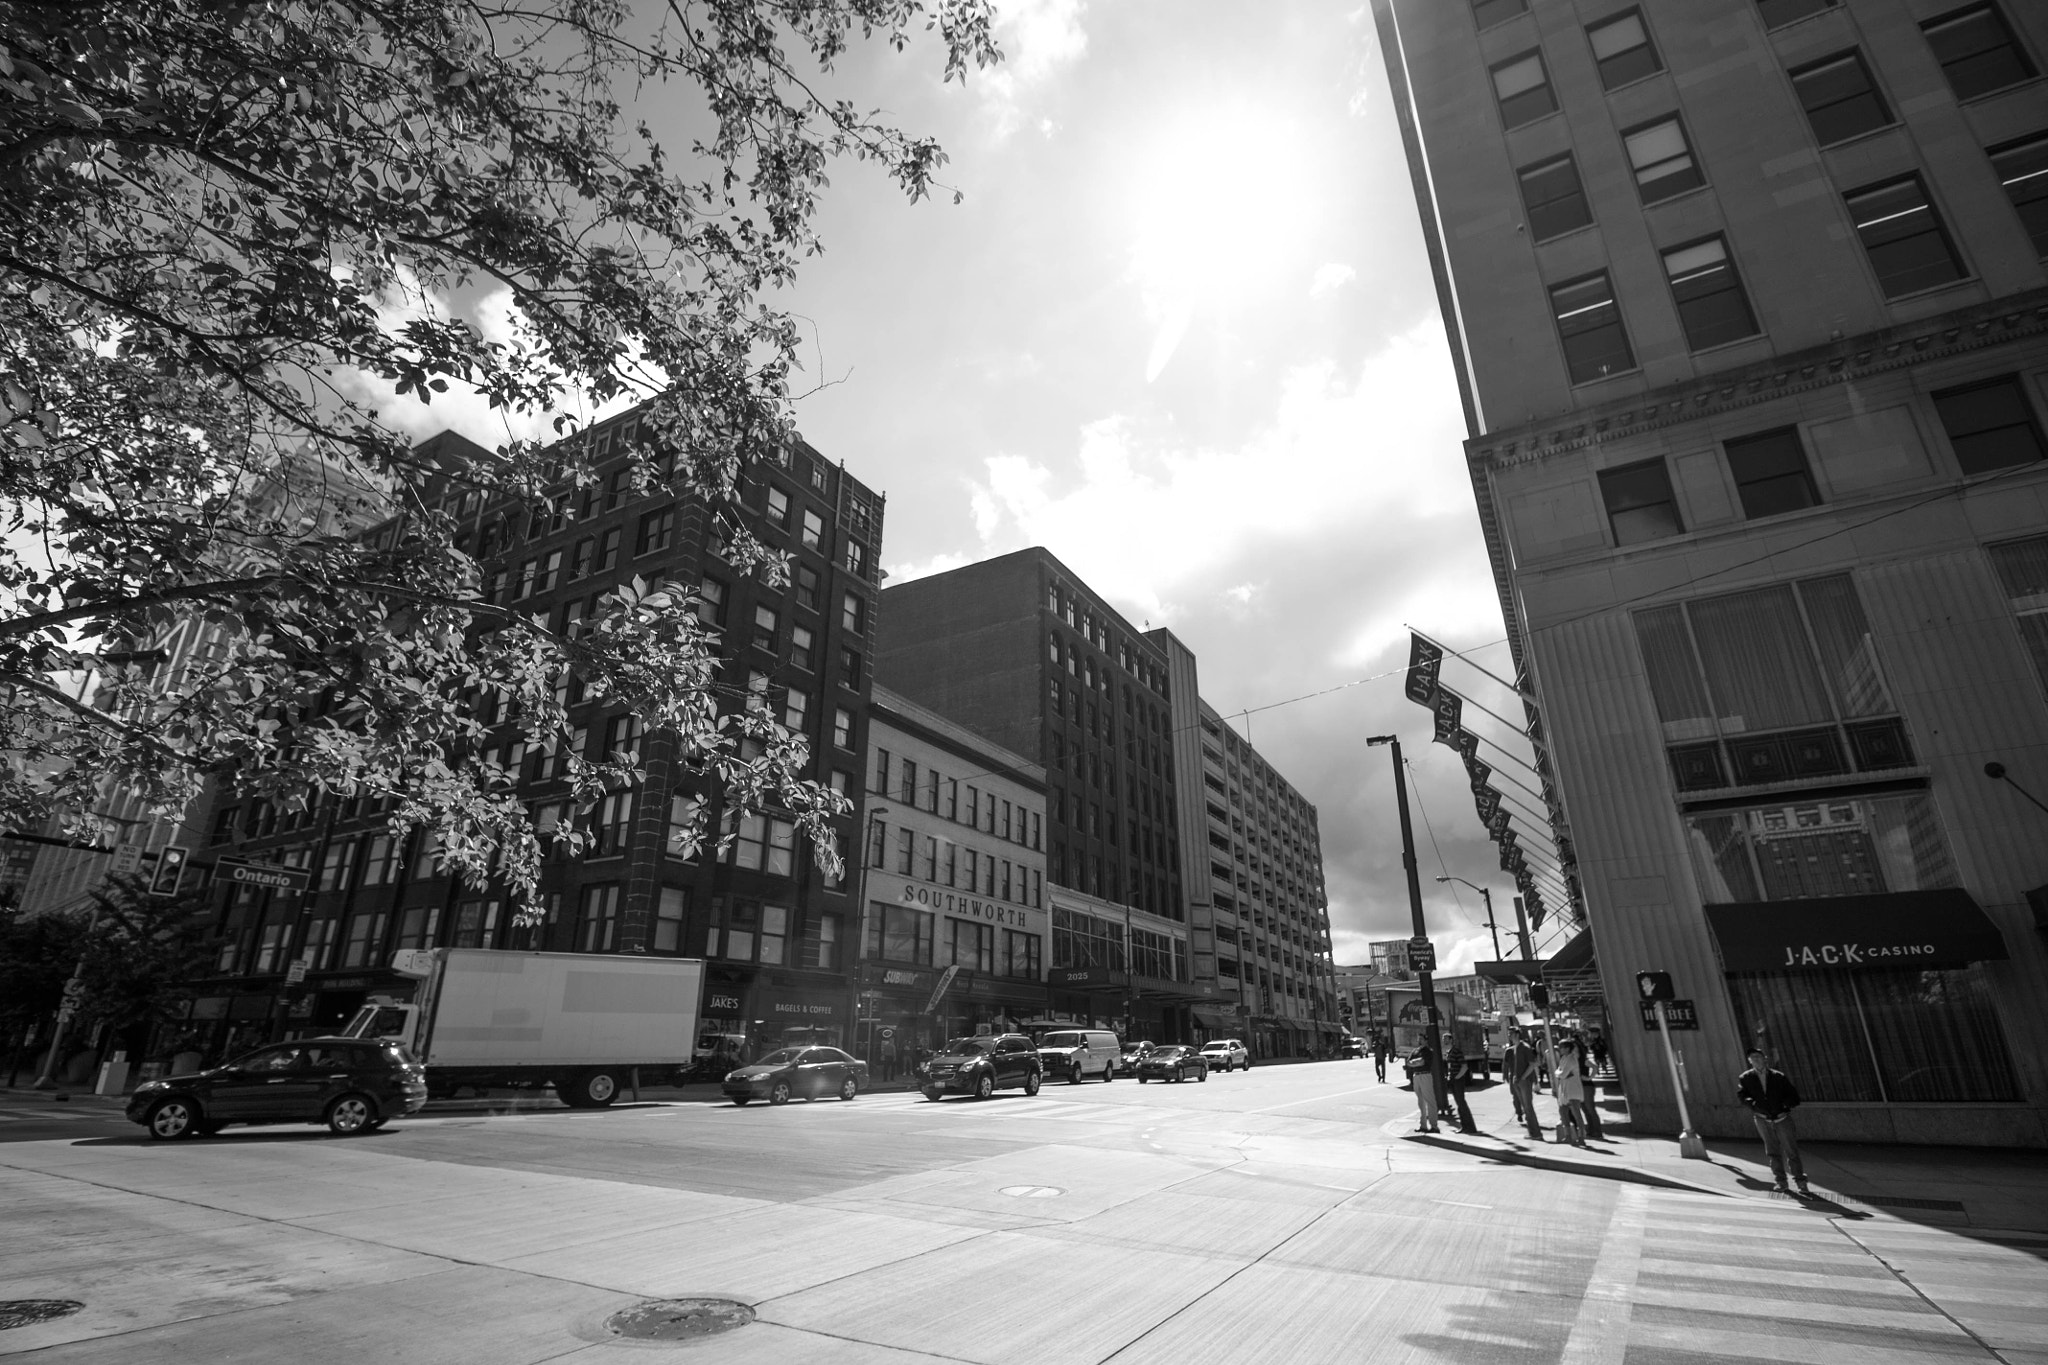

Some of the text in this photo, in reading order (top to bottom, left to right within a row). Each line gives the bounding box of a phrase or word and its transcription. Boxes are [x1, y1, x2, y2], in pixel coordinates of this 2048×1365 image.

[233, 867, 291, 887] Ontario
[904, 885, 1026, 927] SOUTHWORTH
[1867, 944, 1935, 957] CASINO
[883, 970, 919, 985] SUBWAY
[1066, 971, 1089, 981] 2025
[775, 1003, 832, 1014] BAGELS & COFFEE
[1644, 1008, 1693, 1021] HBEE
